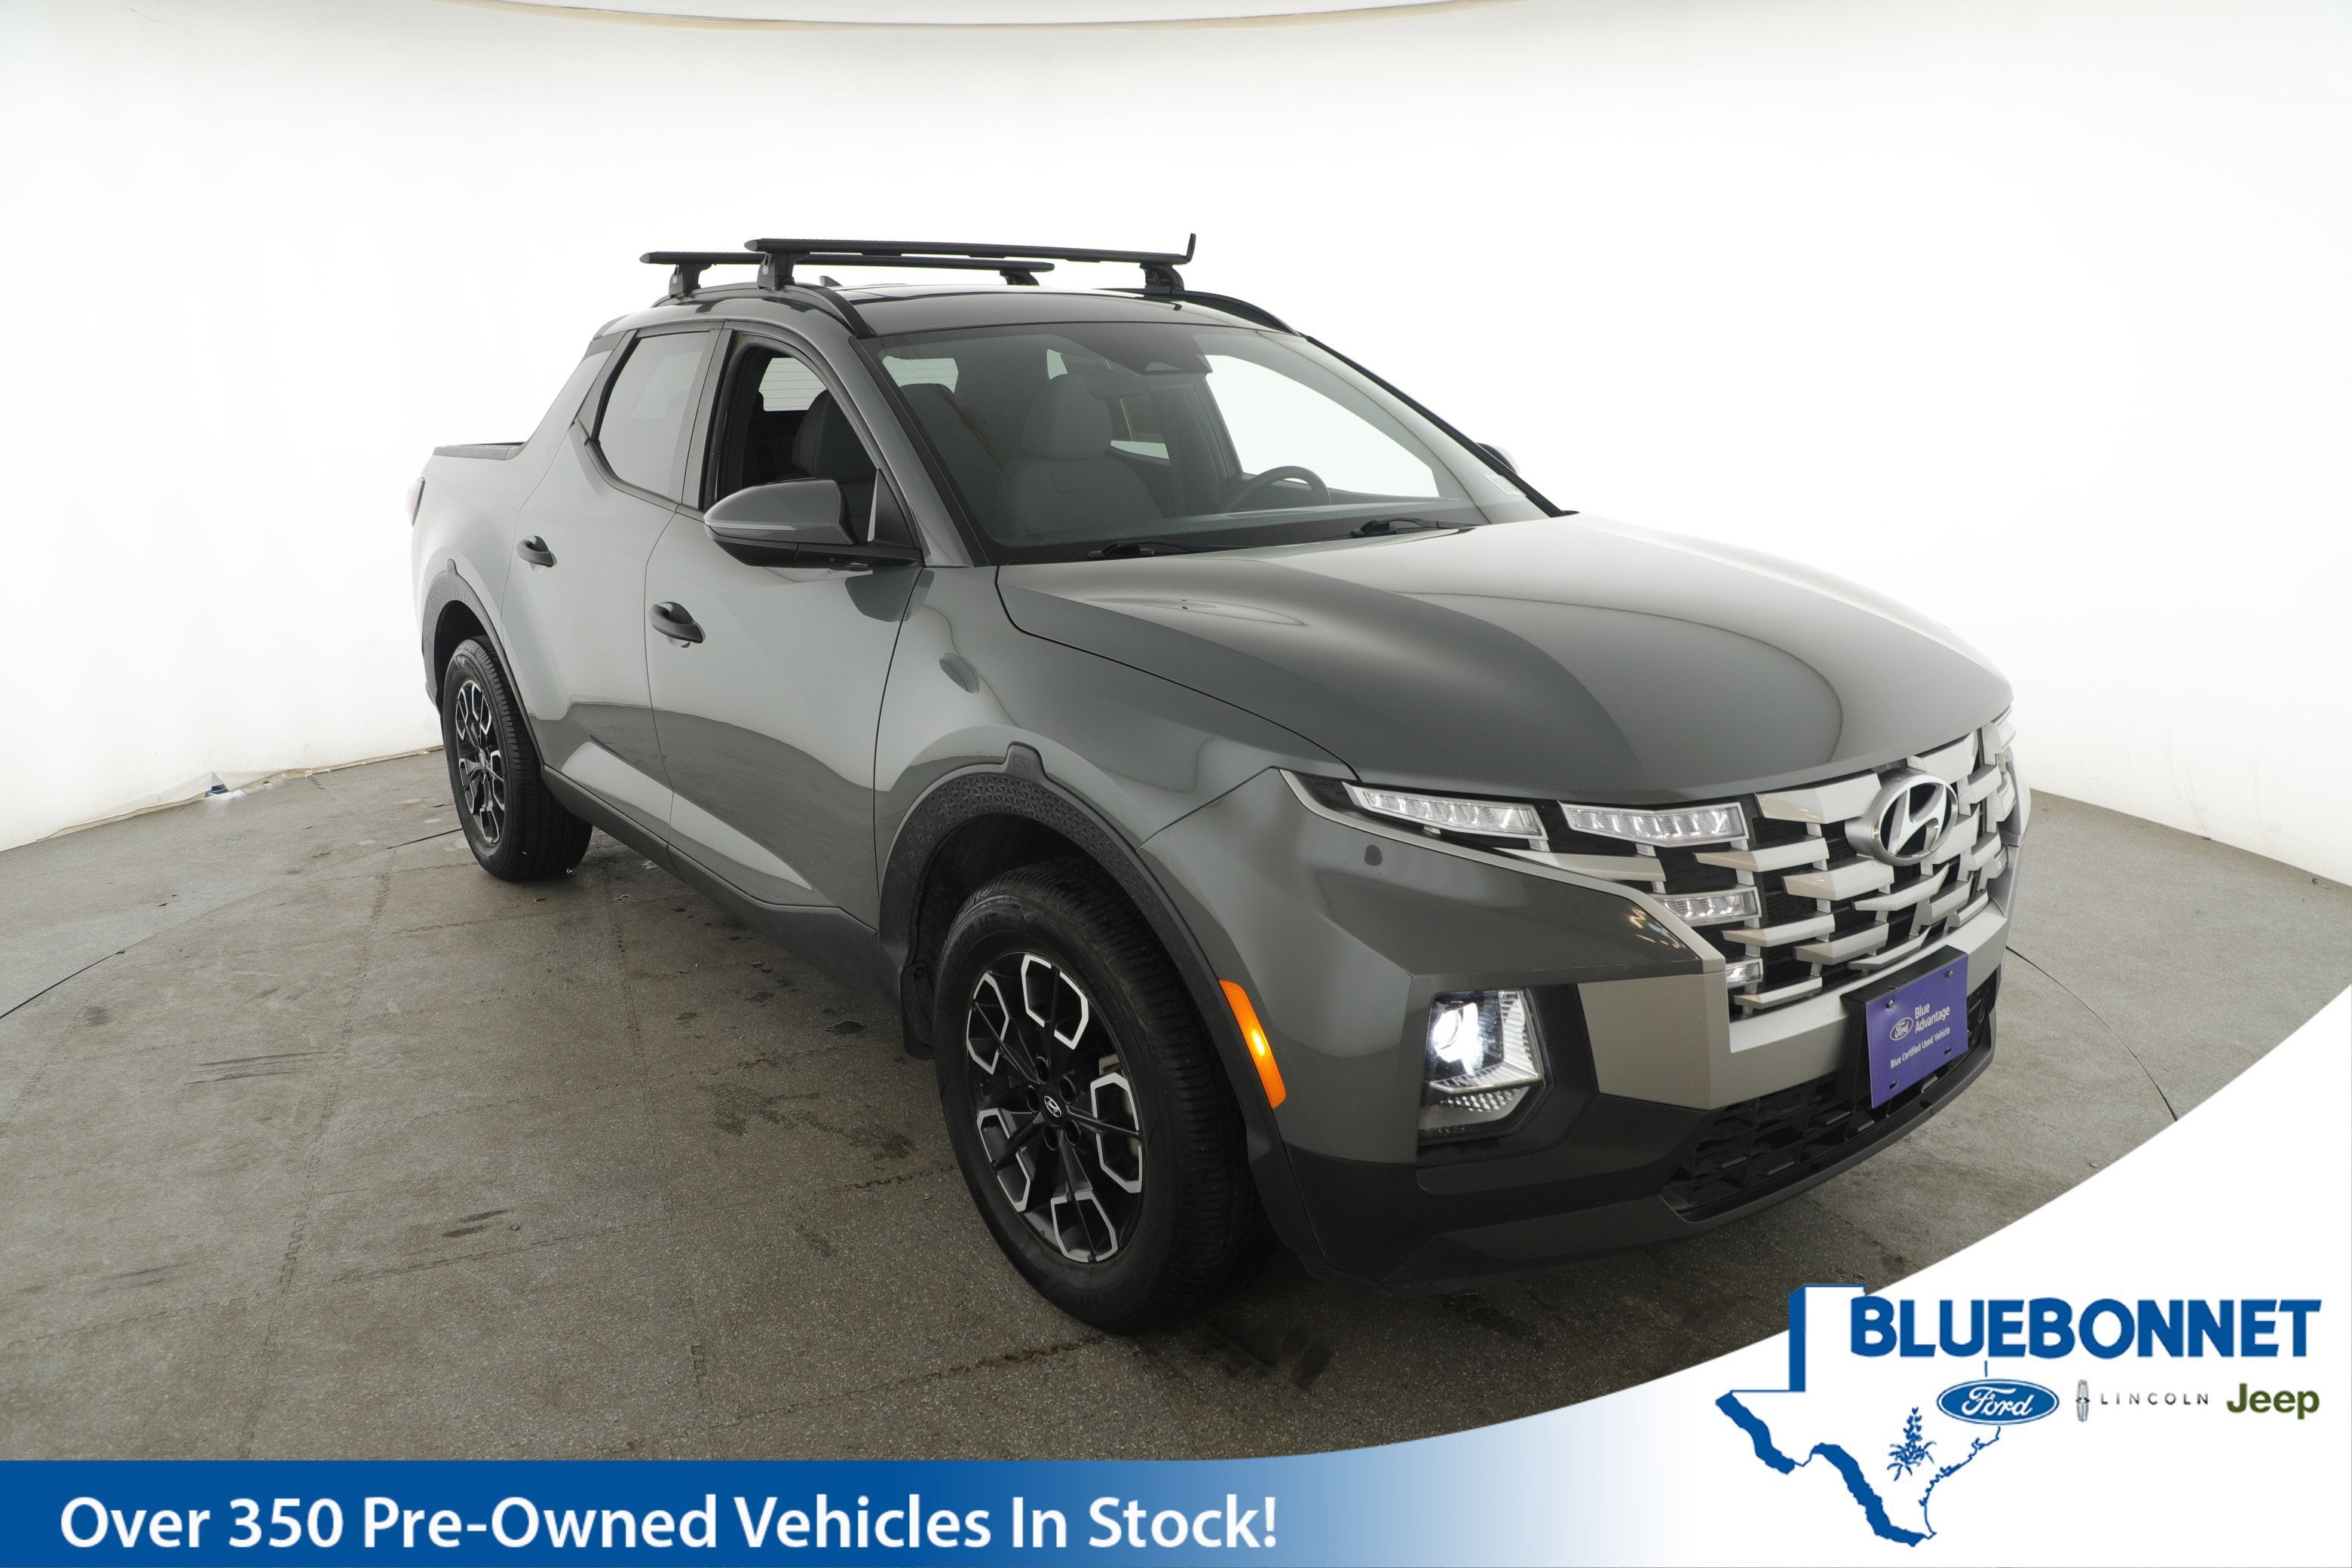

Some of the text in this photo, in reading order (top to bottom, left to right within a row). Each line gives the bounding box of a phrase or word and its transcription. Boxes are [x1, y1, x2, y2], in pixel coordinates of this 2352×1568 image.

[1915, 1003, 1931, 1018] Blue
[1915, 1006, 1950, 1034] Advantage
[1890, 1027, 1950, 1069] Blue Certified Used Vehicle
